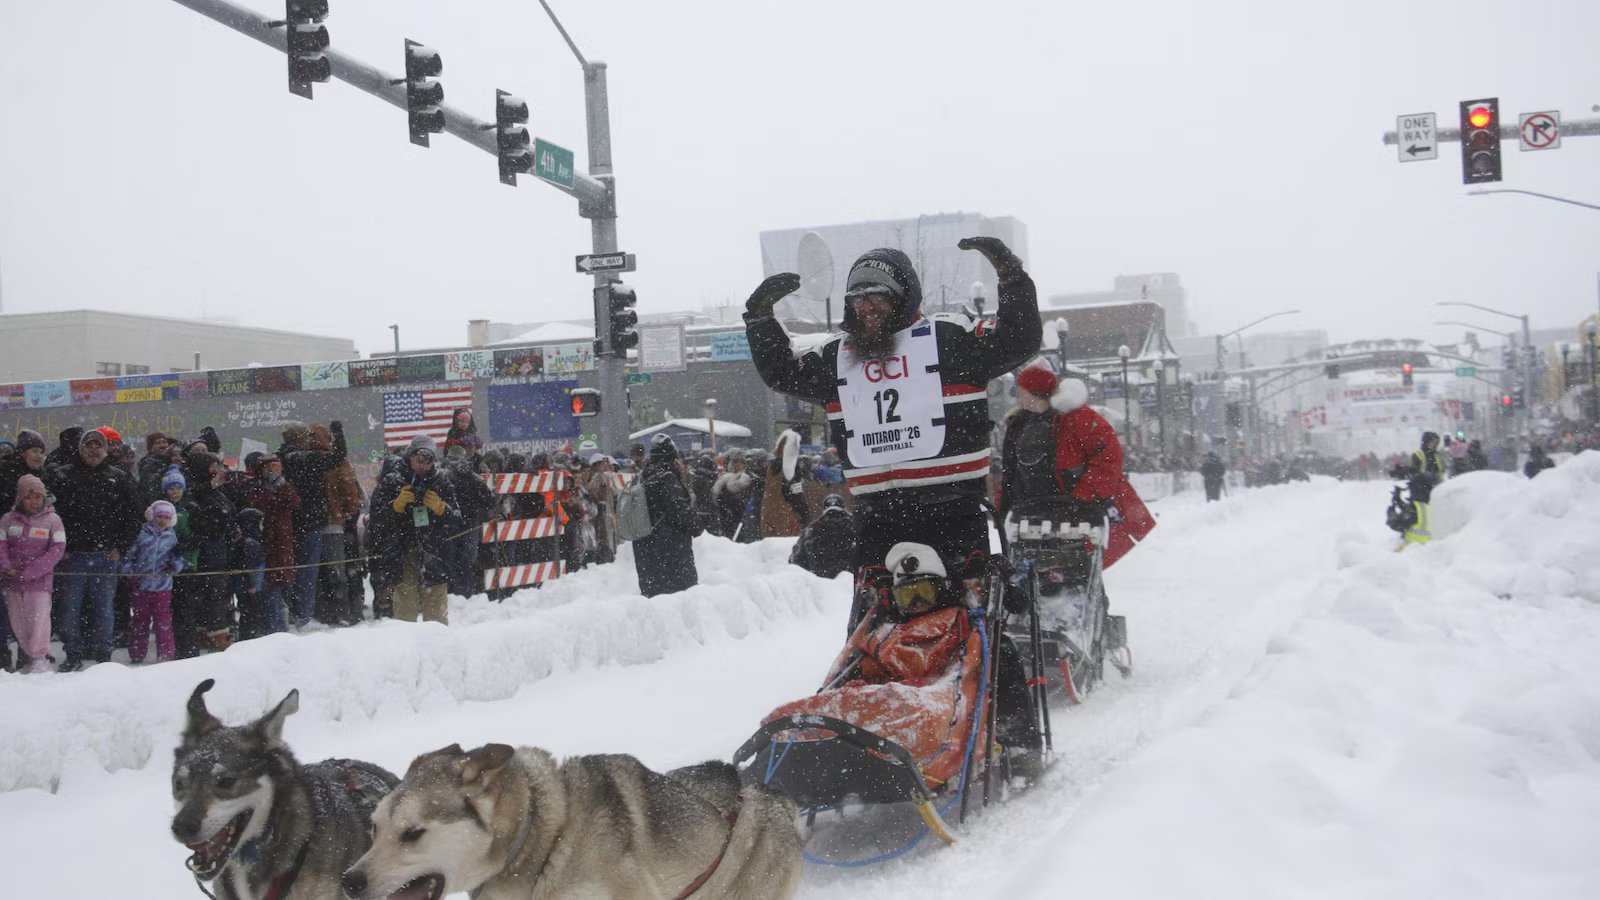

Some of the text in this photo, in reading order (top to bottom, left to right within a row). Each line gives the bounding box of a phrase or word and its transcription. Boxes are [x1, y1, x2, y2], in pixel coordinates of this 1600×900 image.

[1404, 117, 1430, 129] ONE
[1404, 129, 1431, 142] WAY
[541, 150, 555, 174] 4th
[606, 257, 621, 265] WAY
[445, 352, 483, 363] NO ONE
[365, 369, 380, 377] NOT
[449, 361, 460, 373] IS
[462, 360, 494, 371] ABOVE
[864, 355, 910, 384] GCI
[476, 369, 495, 379] LAW
[490, 377, 518, 386] Alaska
[519, 376, 527, 384] is
[544, 374, 556, 382] for
[558, 372, 577, 381] Sale
[212, 382, 250, 396] UKRAINE
[399, 383, 432, 392] America
[234, 401, 262, 412] Thank
[873, 388, 902, 425] 12
[156, 415, 186, 438] up
[862, 429, 901, 447] IDITAROD
